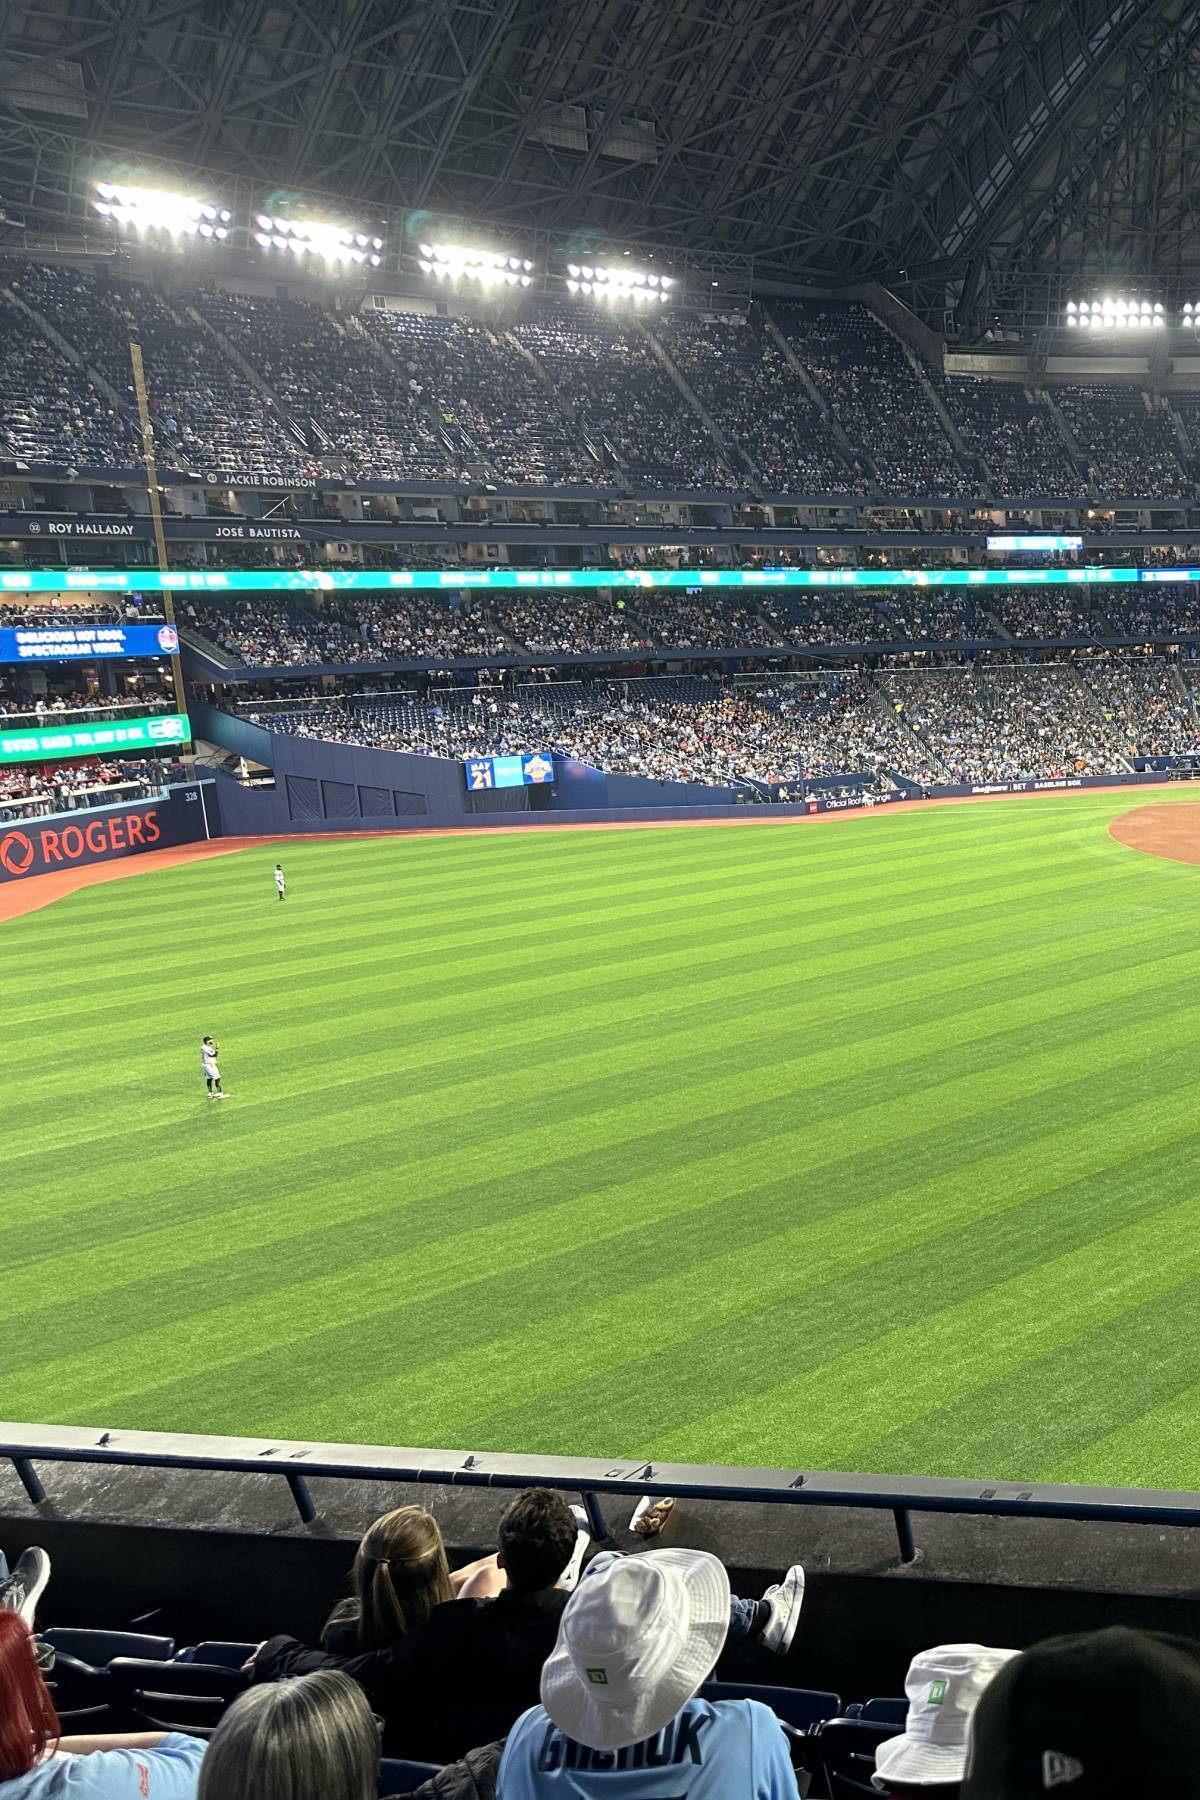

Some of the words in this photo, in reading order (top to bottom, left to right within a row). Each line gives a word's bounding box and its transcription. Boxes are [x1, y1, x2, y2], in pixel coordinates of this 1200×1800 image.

[224, 474, 260, 485] JACKIE
[262, 476, 316, 488] ROBINSON
[48, 523, 72, 534] ROY
[76, 524, 134, 535] HALLADAY
[216, 526, 244, 537] JOSÉ
[249, 528, 302, 538] BAUTISTA
[472, 770, 492, 789] 21
[826, 798, 847, 808] Official
[40, 811, 160, 863] ROGERS
